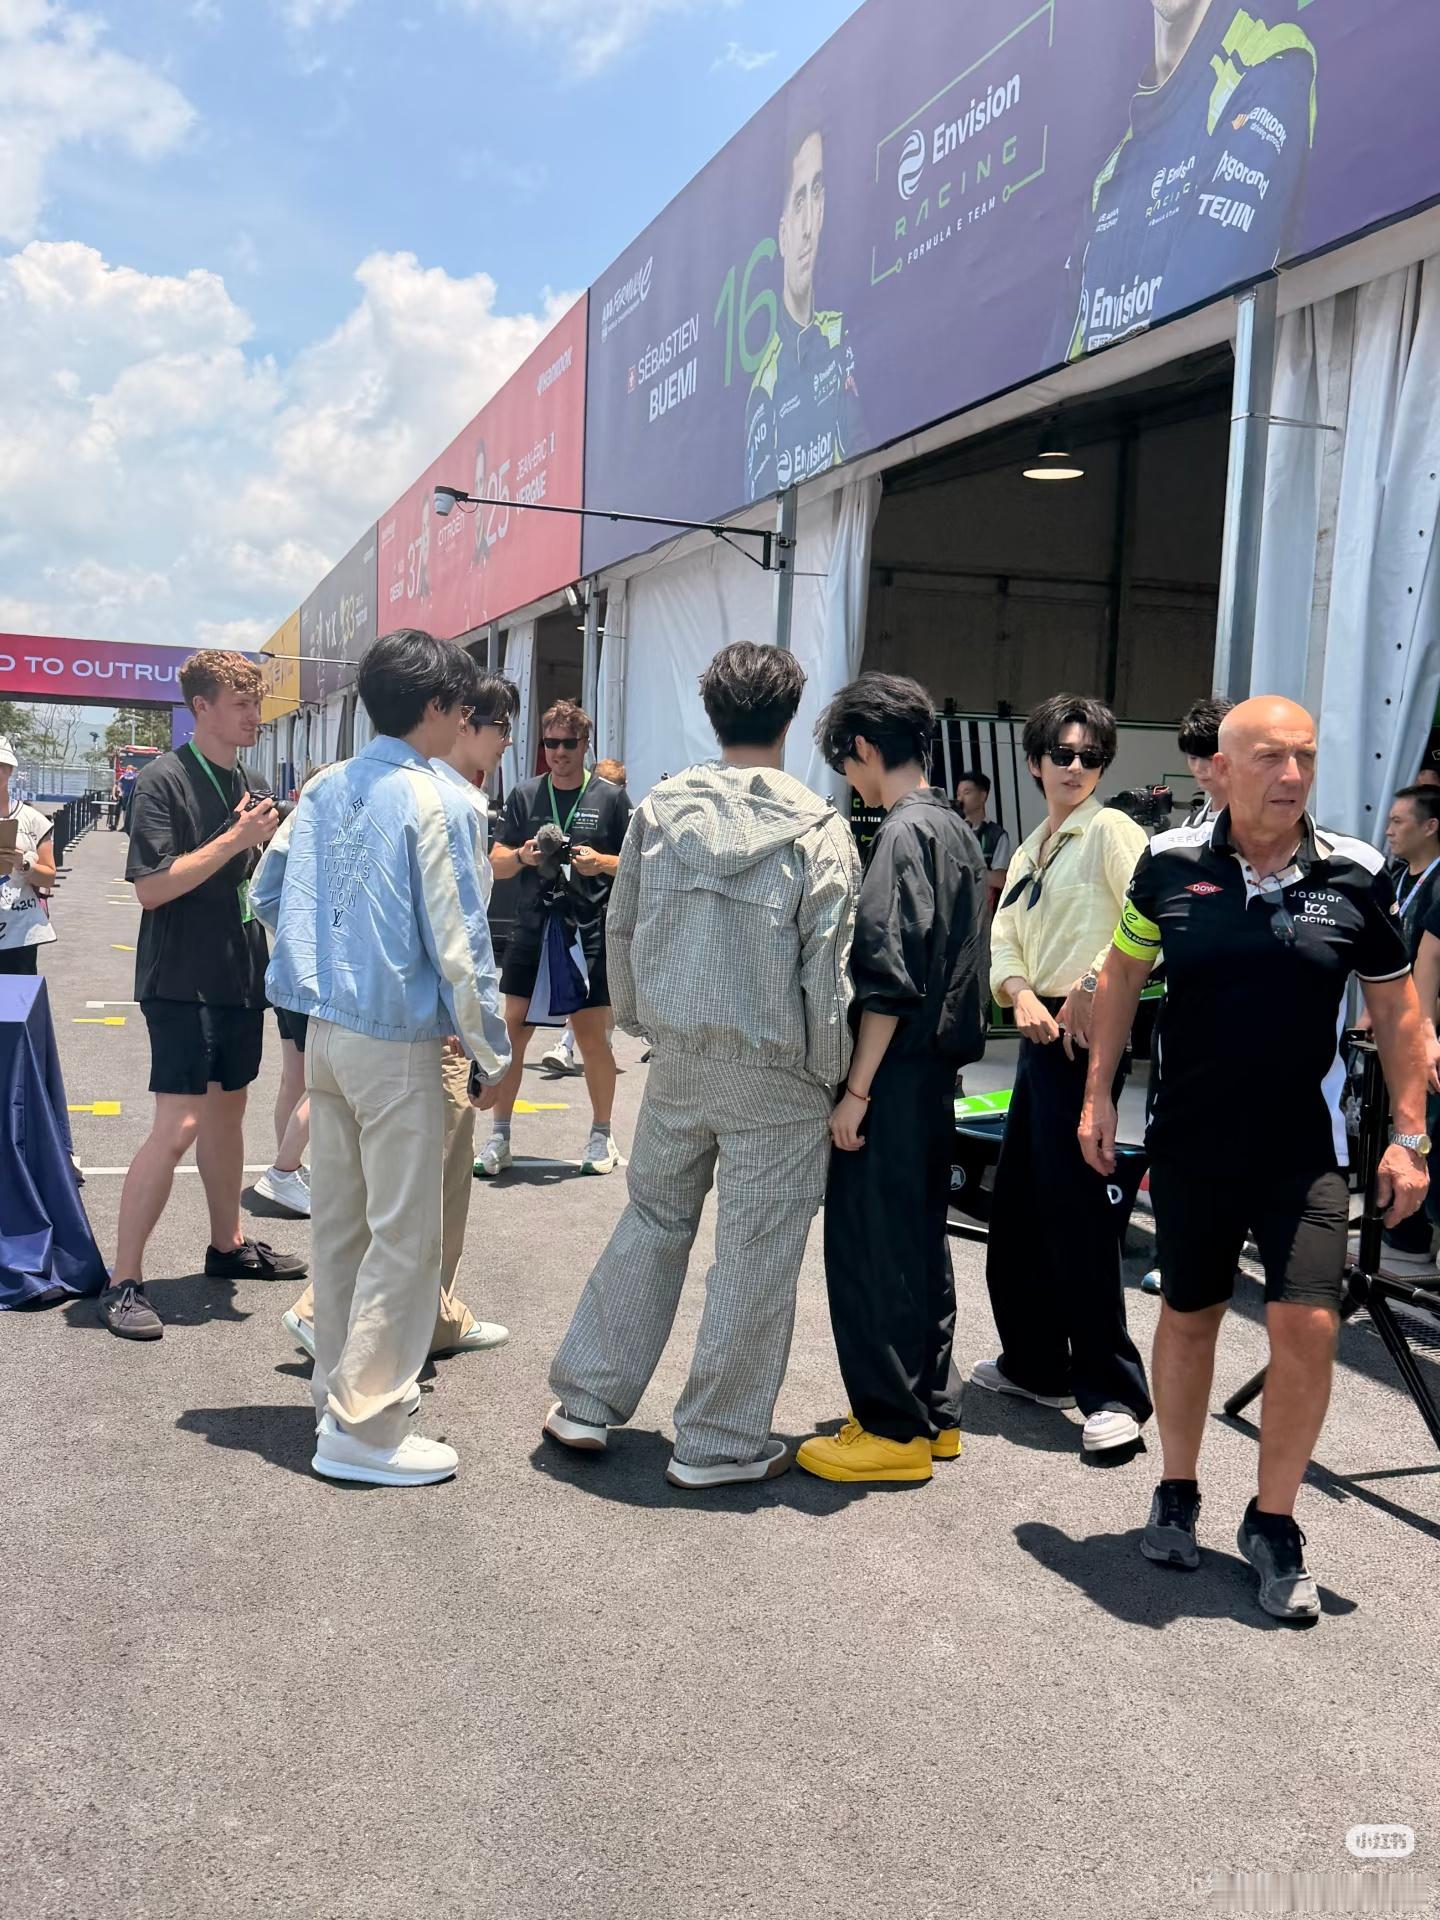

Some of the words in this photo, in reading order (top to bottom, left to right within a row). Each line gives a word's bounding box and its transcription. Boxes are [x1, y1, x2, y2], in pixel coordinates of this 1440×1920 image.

[932, 74, 1021, 164] Envision
[895, 135, 1017, 241] RACING
[907, 225, 951, 264] FORMULA
[956, 217, 963, 231] E
[967, 195, 996, 224] TEAM
[713, 237, 777, 388] 16
[637, 313, 700, 385] SÉBASTIEN
[649, 357, 698, 423] BUEMI
[24, 655, 65, 676] TO
[72, 659, 181, 683] OUTRU
[323, 855, 370, 879] LOUIS
[329, 889, 357, 908] TON
[1193, 884, 1217, 893] DOW
